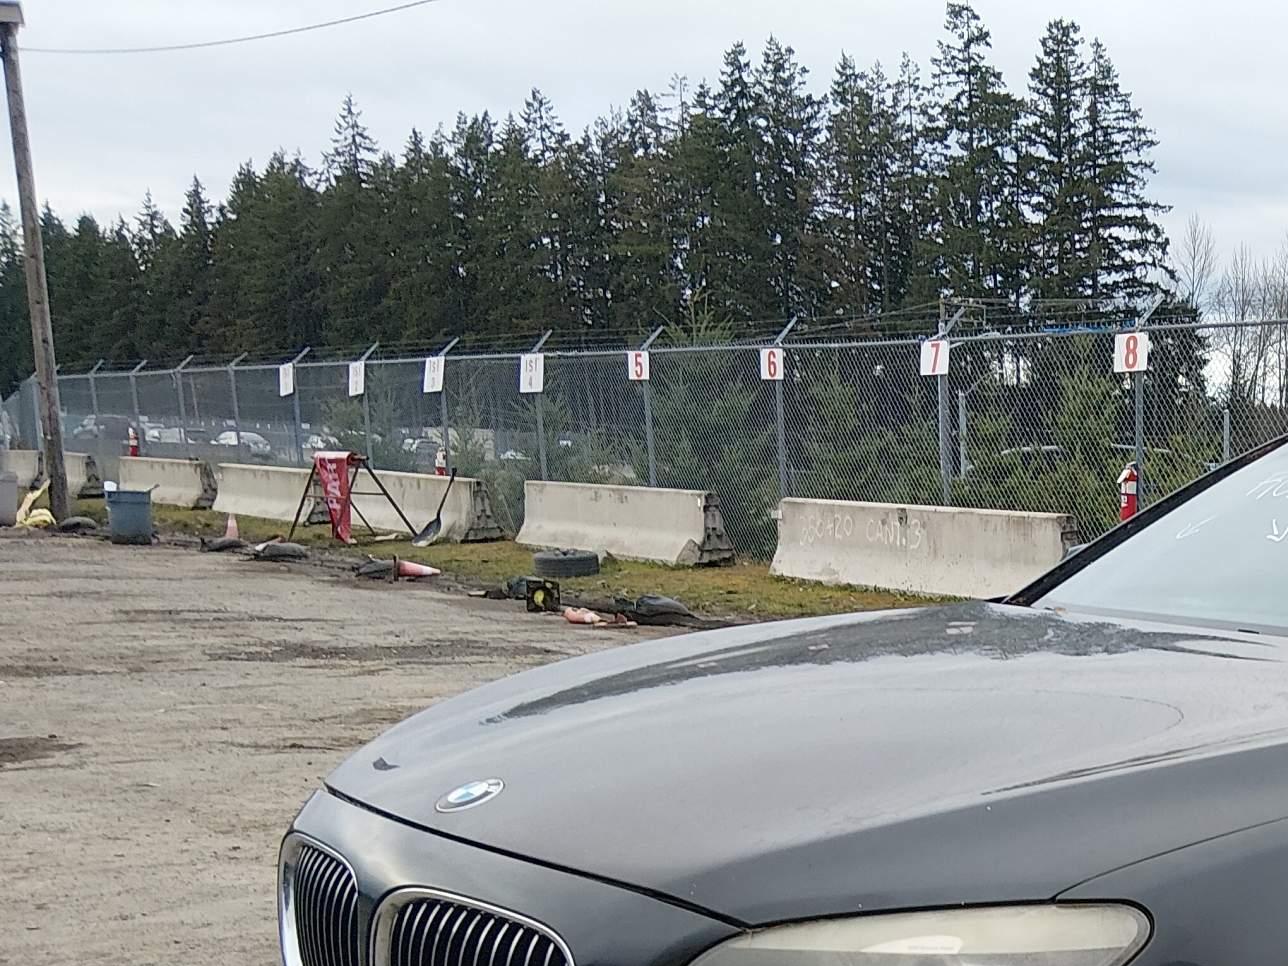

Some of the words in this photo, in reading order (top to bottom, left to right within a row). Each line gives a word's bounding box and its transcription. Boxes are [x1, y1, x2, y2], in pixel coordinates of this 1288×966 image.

[634, 353, 644, 378] 5
[767, 350, 777, 378] 6
[931, 342, 941, 374] 7
[1124, 335, 1139, 370] 8
